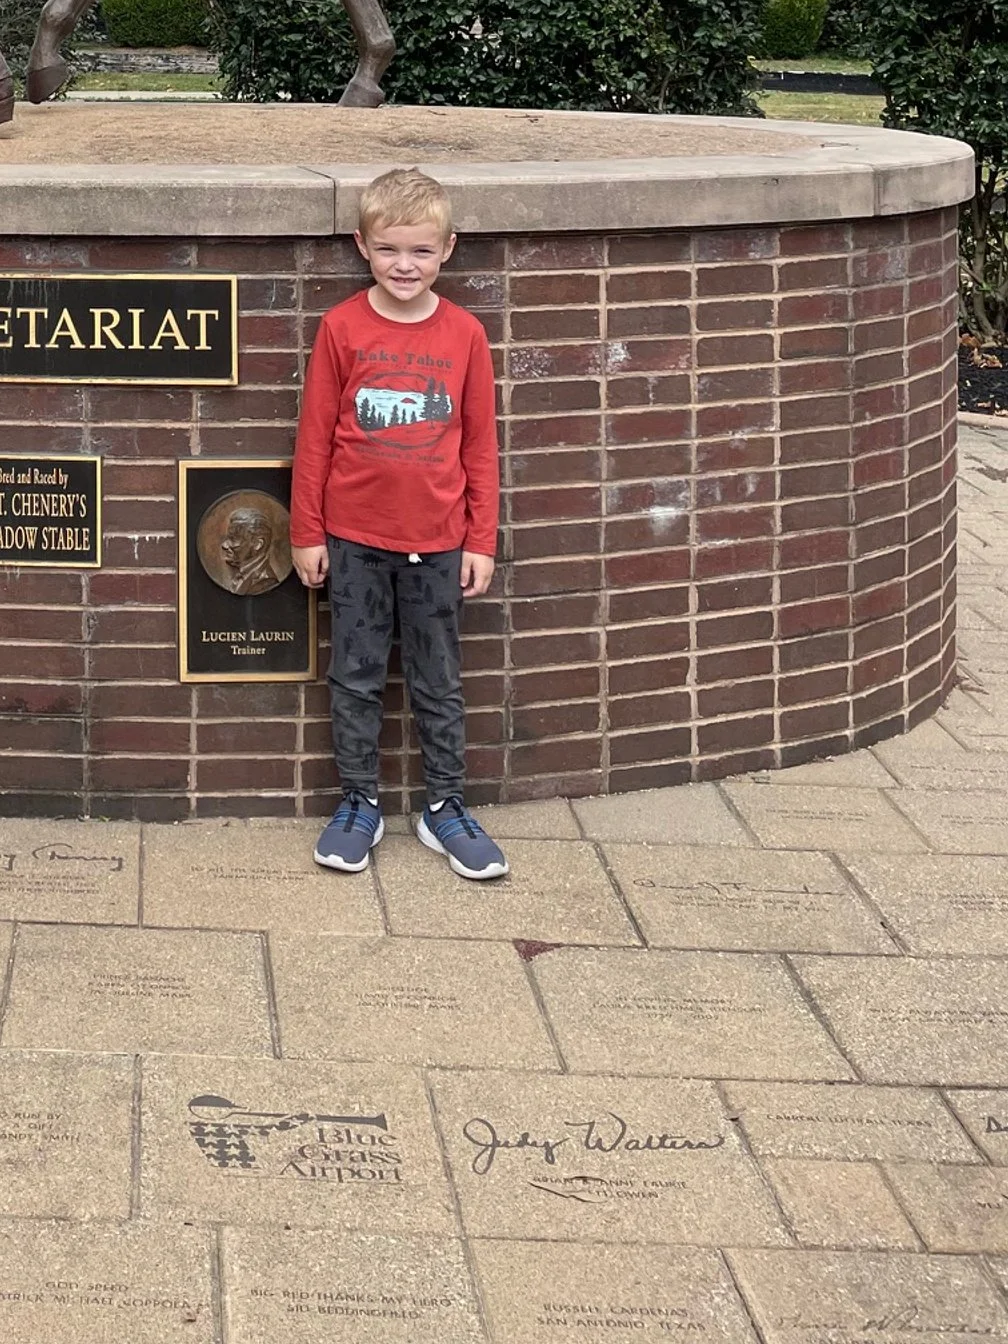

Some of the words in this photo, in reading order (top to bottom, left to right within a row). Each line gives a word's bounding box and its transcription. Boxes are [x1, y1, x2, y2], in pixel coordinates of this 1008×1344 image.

[17, 467, 31, 484] and
[33, 467, 56, 485] Raced
[58, 468, 69, 489] by
[12, 492, 87, 518] CHENERY'S
[41, 526, 91, 551] STABLE
[201, 630, 247, 643] LUCIEN
[250, 629, 295, 642] LAURIN
[231, 645, 266, 655] Trainer
[317, 1127, 398, 1147] Blue
[297, 1143, 403, 1165] Grass
[280, 1161, 404, 1184] Airport
